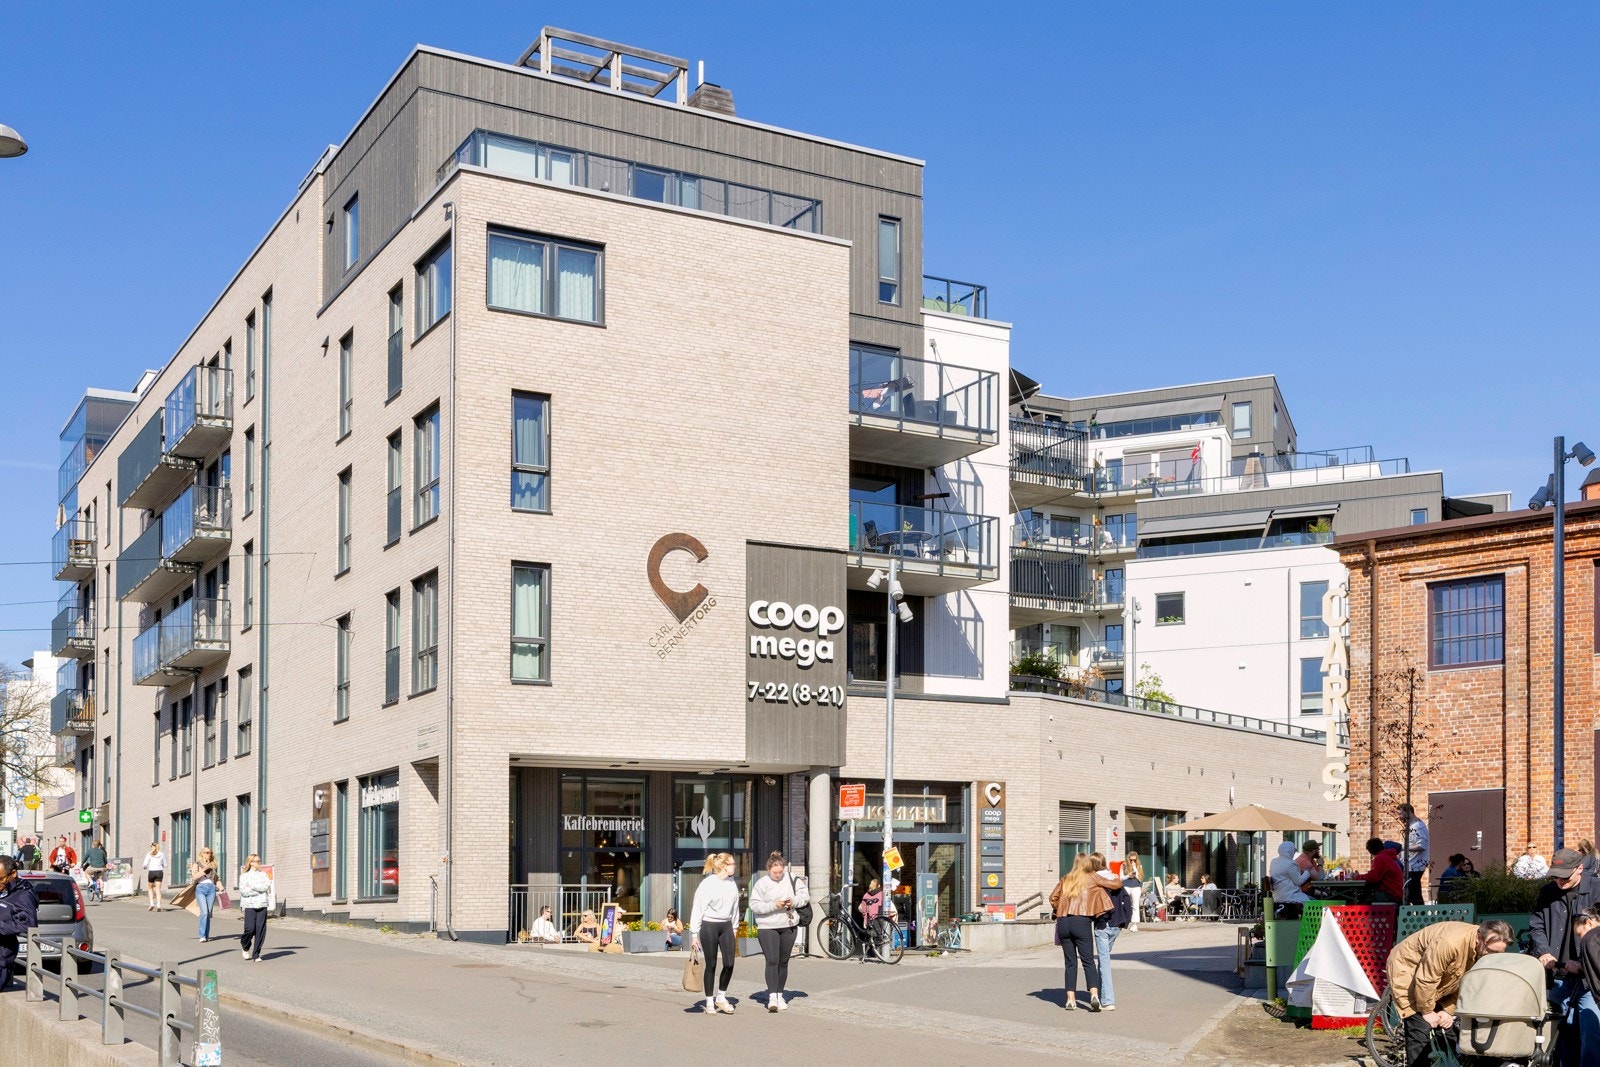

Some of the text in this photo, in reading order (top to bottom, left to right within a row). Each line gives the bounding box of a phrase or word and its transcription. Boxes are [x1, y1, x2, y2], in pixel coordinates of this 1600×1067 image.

[748, 600, 845, 636] coop
[648, 624, 674, 648] CARL
[749, 635, 834, 667] mega
[748, 681, 845, 707] 7-22 (8-21)
[1320, 588, 1349, 802] CARLS
[563, 815, 646, 831] Kaffebrenneriet
[866, 805, 937, 821] KOMMEN
